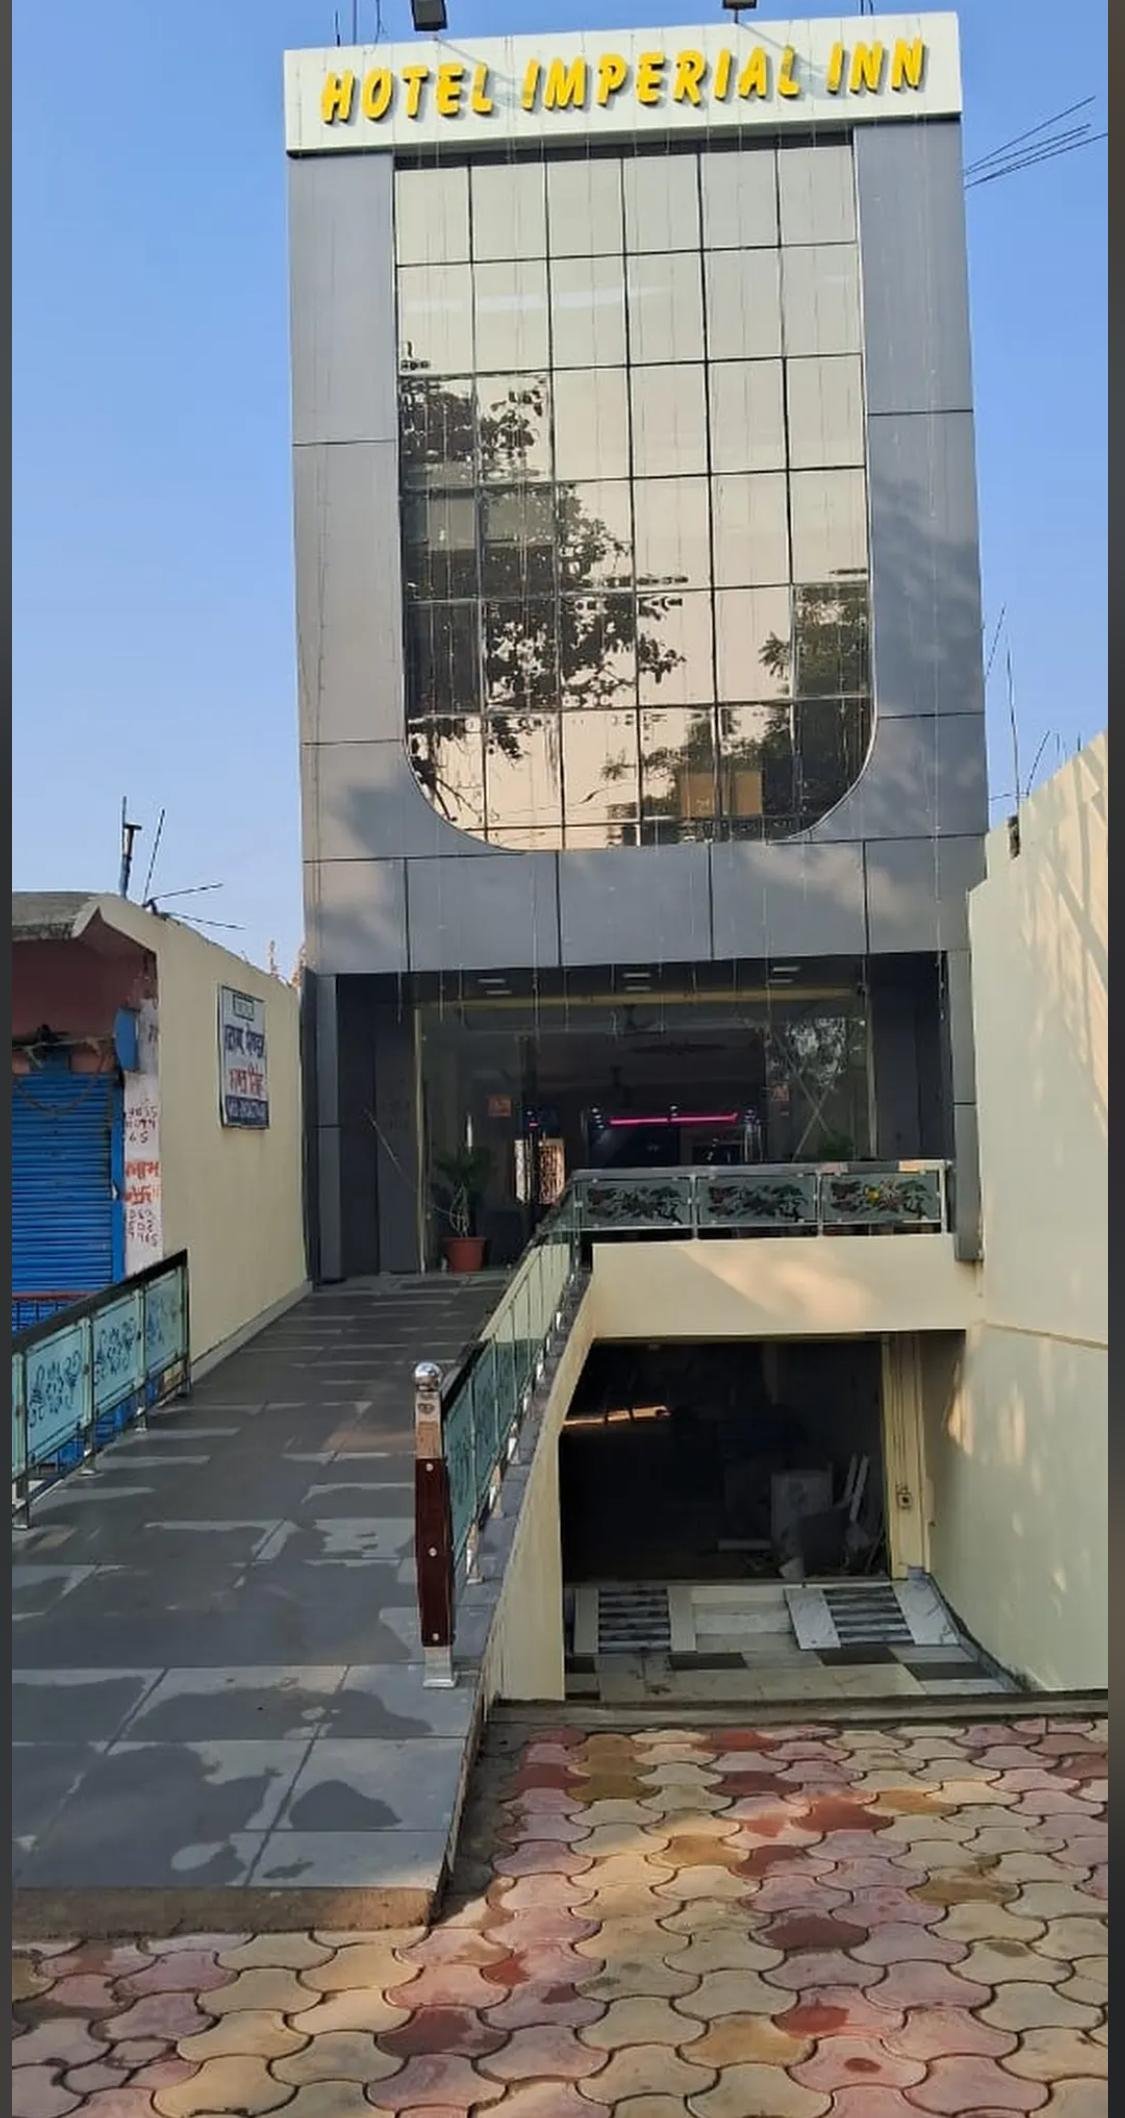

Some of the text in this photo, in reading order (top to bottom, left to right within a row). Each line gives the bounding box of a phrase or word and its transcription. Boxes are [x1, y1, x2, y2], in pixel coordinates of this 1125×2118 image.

[320, 37, 925, 124] HOTEL IMPERIAL INN
